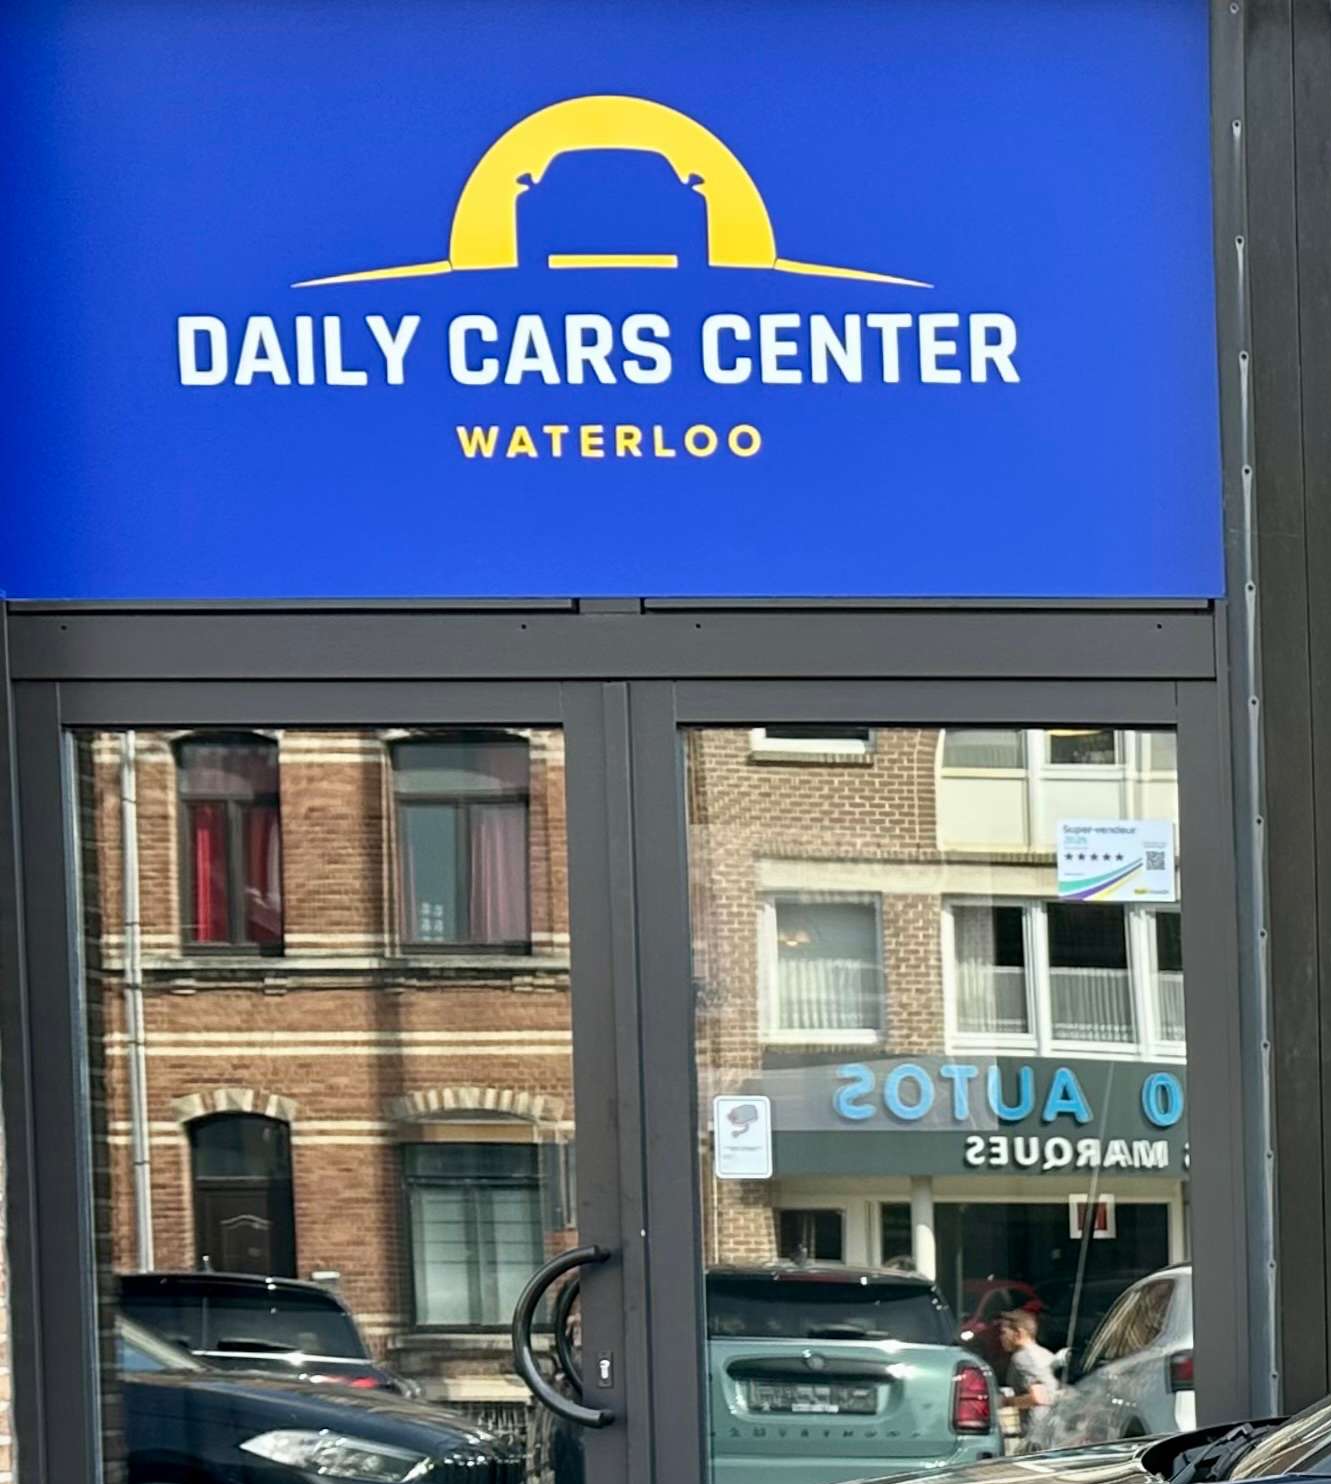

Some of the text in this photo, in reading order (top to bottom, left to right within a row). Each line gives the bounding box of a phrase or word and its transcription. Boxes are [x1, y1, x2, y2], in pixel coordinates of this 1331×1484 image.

[177, 312, 1021, 387] DAILY CARS CENTER
[456, 424, 763, 459] WATERLOO
